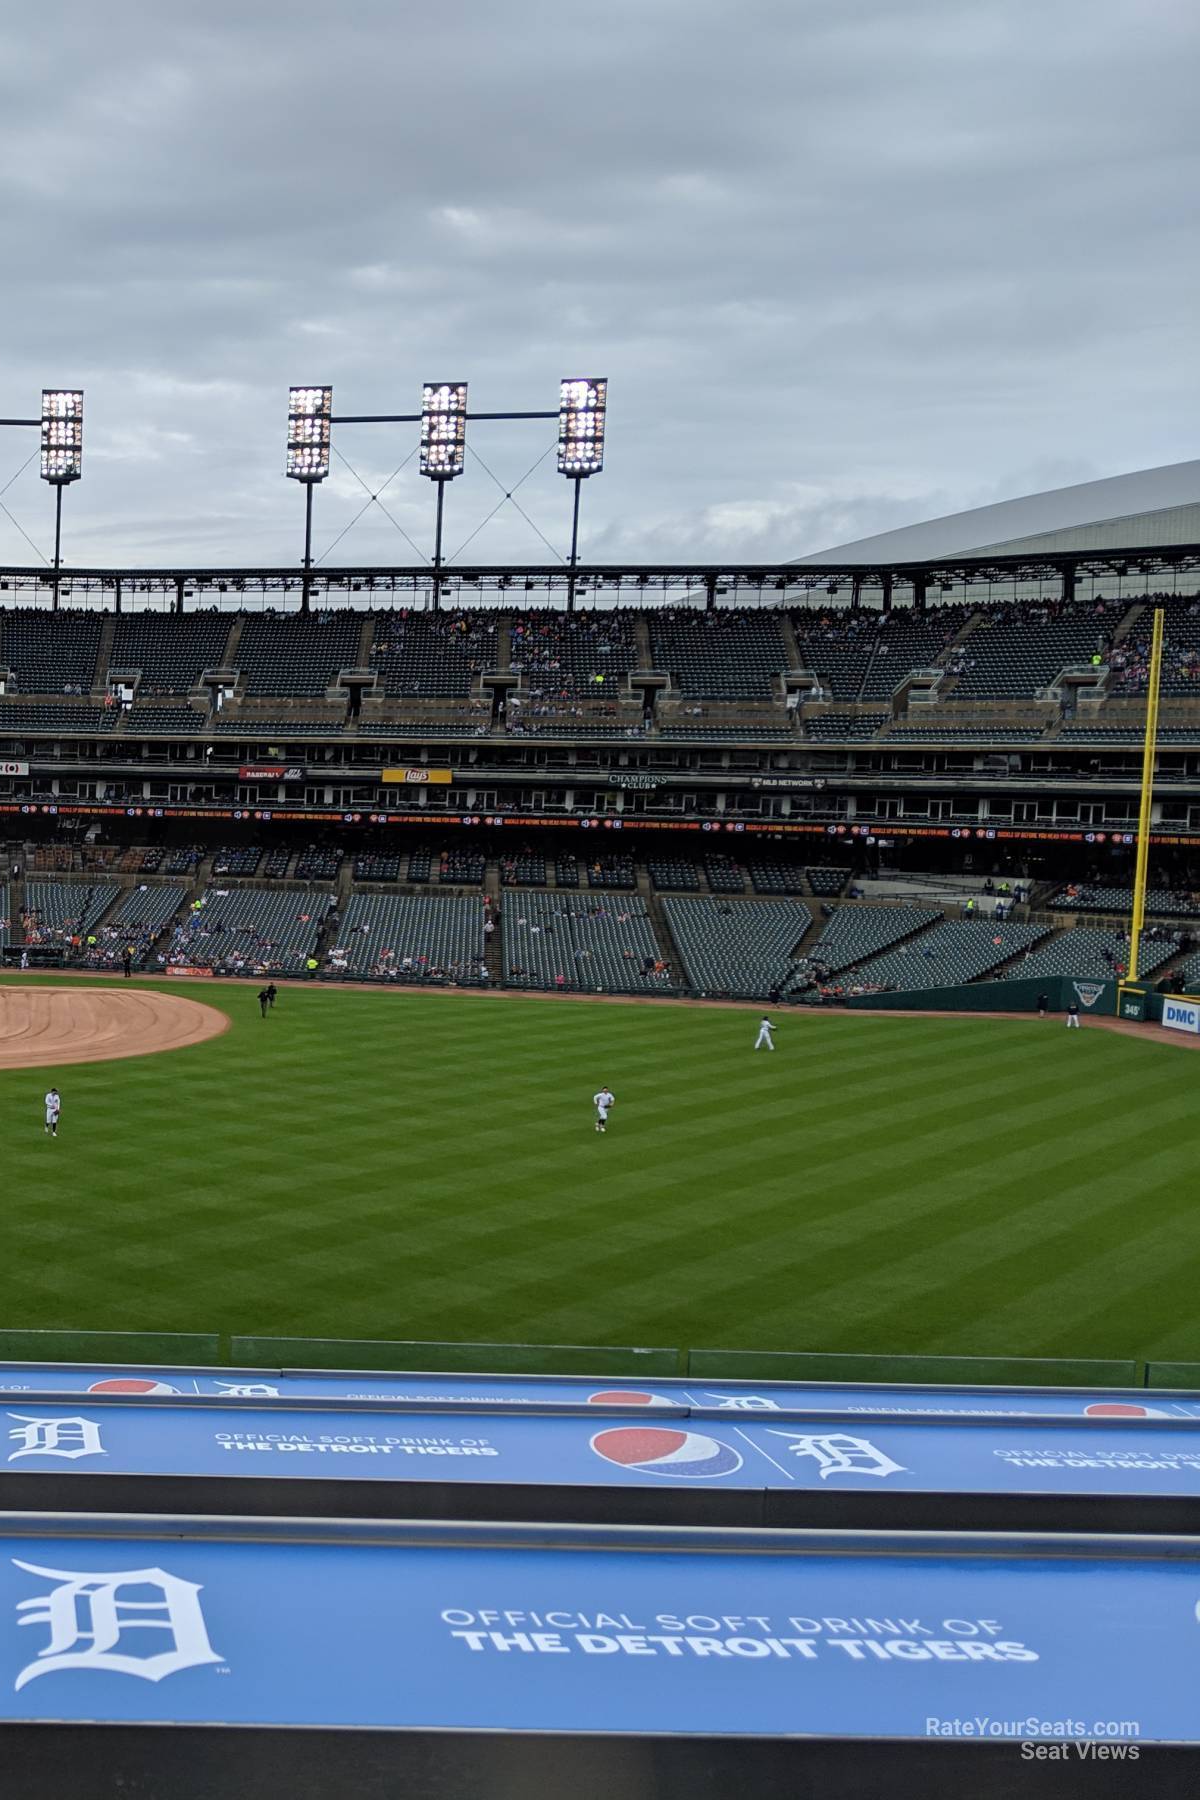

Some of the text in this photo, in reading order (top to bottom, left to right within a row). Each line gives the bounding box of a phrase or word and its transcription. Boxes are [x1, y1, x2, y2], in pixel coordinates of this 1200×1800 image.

[1166, 1007, 1195, 1024] DMC
[215, 1434, 312, 1442] OFFICIAL
[278, 1444, 393, 1452] DETROIT
[399, 1446, 498, 1455] TIGERS
[1064, 1460, 1180, 1468] DETROIT
[442, 1610, 1002, 1635] OFFICIAL SOFT DRINK OF
[452, 1631, 1039, 1661] THE DETROIT TIGERS
